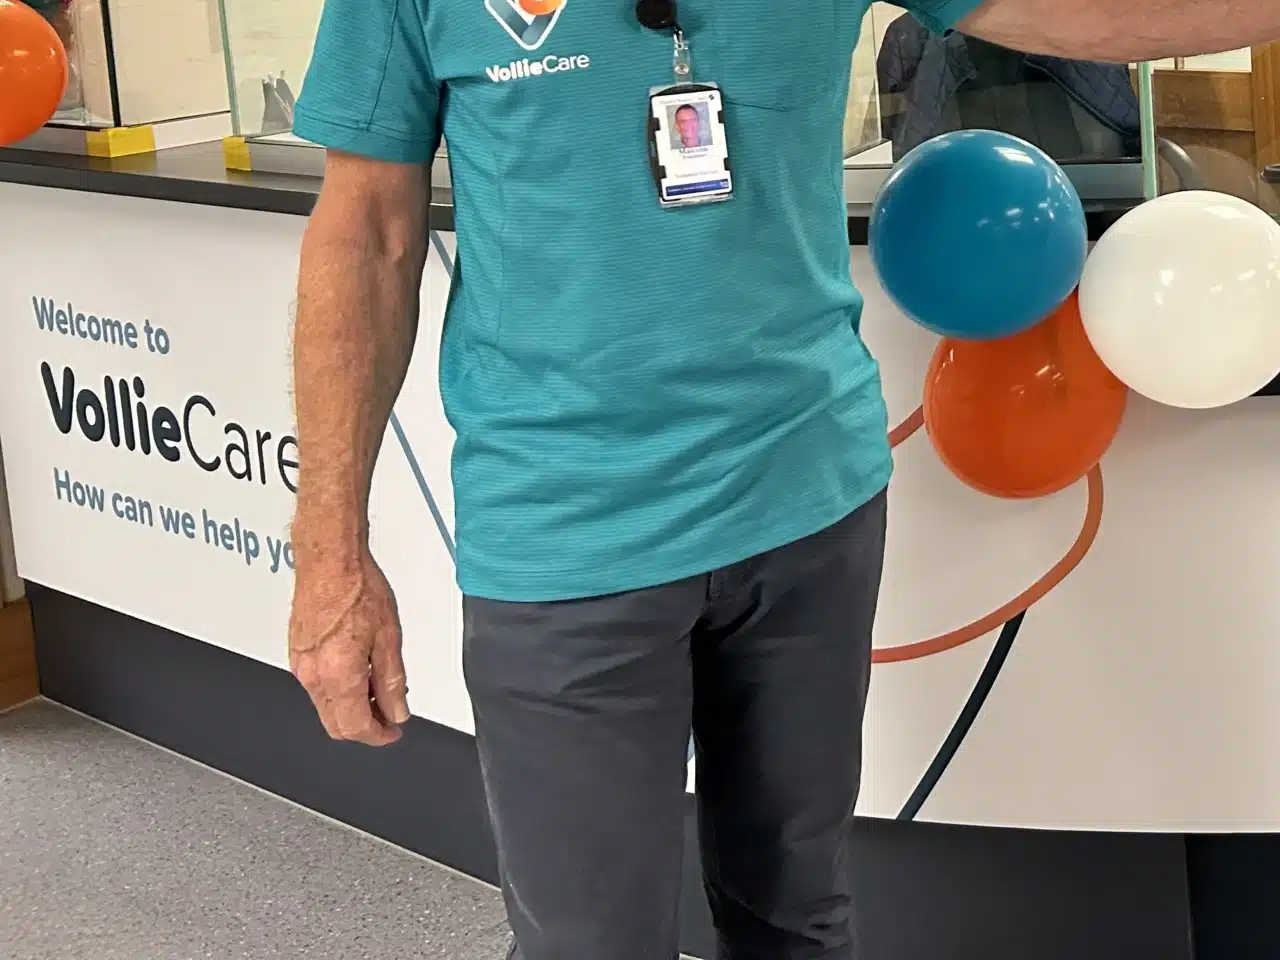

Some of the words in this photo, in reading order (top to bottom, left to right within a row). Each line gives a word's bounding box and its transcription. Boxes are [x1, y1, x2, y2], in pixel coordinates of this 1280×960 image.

[485, 54, 590, 83] VollieCare
[32, 295, 138, 349] Welcome
[144, 318, 170, 355] to
[40, 360, 299, 494] VollieCare
[53, 466, 105, 512] How
[111, 492, 153, 527] can
[159, 504, 196, 539] we
[202, 508, 260, 566] help
[266, 535, 296, 574] yo
